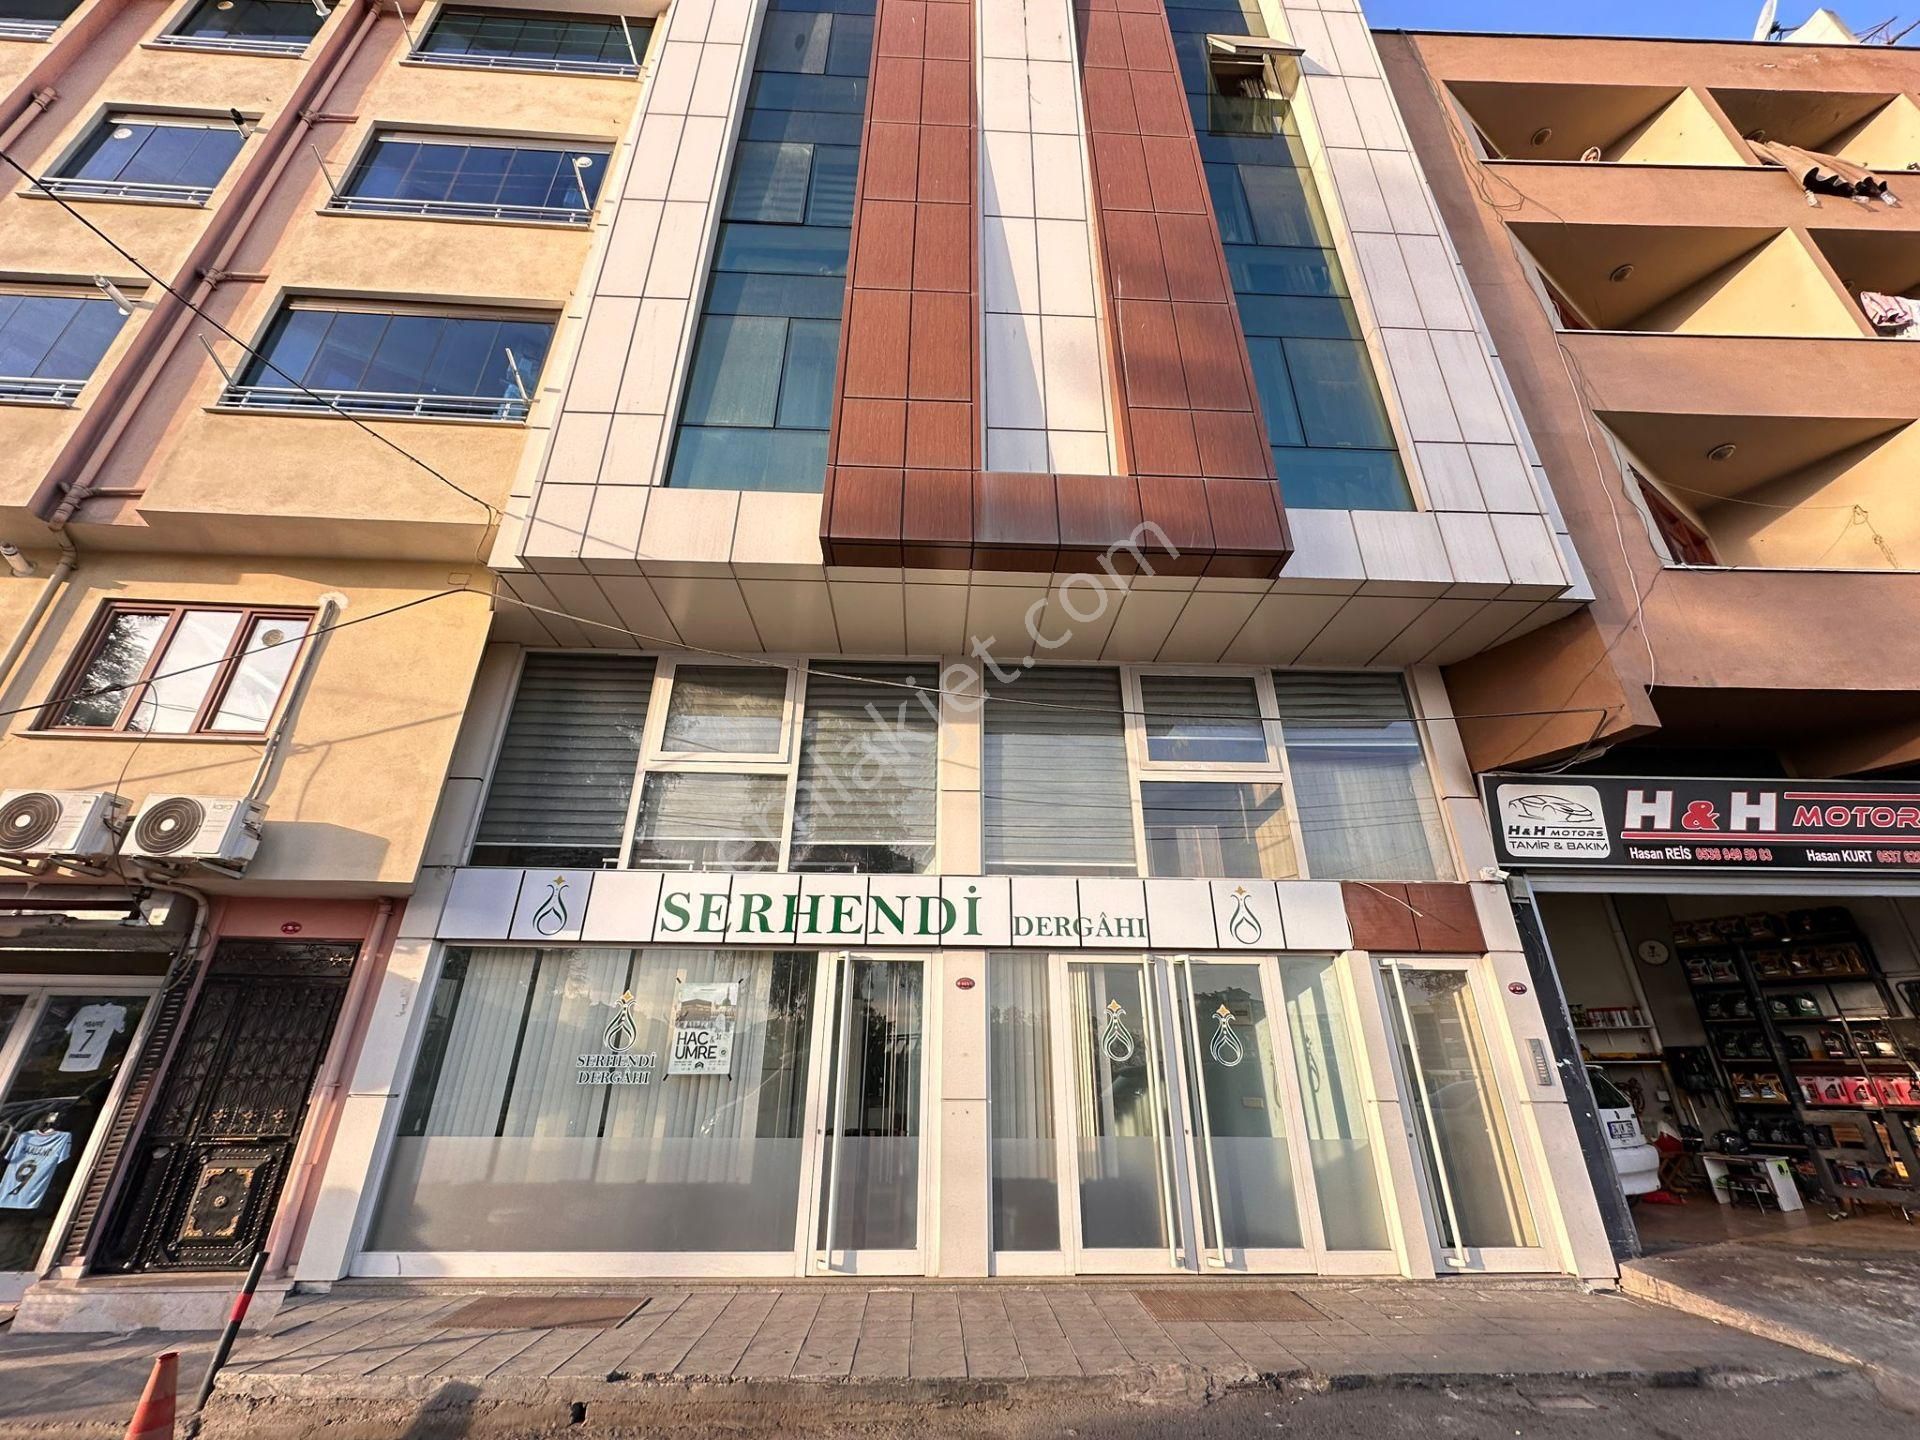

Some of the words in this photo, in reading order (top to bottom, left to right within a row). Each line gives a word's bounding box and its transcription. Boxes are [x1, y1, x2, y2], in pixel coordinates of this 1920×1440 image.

[1550, 829, 1604, 837] MOTORS
[1509, 840, 1550, 850] TAMİR
[1567, 842, 1609, 851] BAKIM
[1629, 847, 1664, 860] Hasan
[1665, 845, 1692, 860] REİS
[1806, 849, 1841, 862] Hasan
[1841, 849, 1872, 863] KURT
[660, 885, 983, 937] SERHENDİ
[1013, 911, 1146, 938] DERGÂHI
[79, 1030, 96, 1052] 7
[677, 1031, 709, 1046] HAC
[576, 1052, 657, 1068] SERHENDİ
[675, 1045, 717, 1060] UMRE
[576, 1067, 651, 1085] DERGÂHI
[8, 1160, 37, 1195] 9
